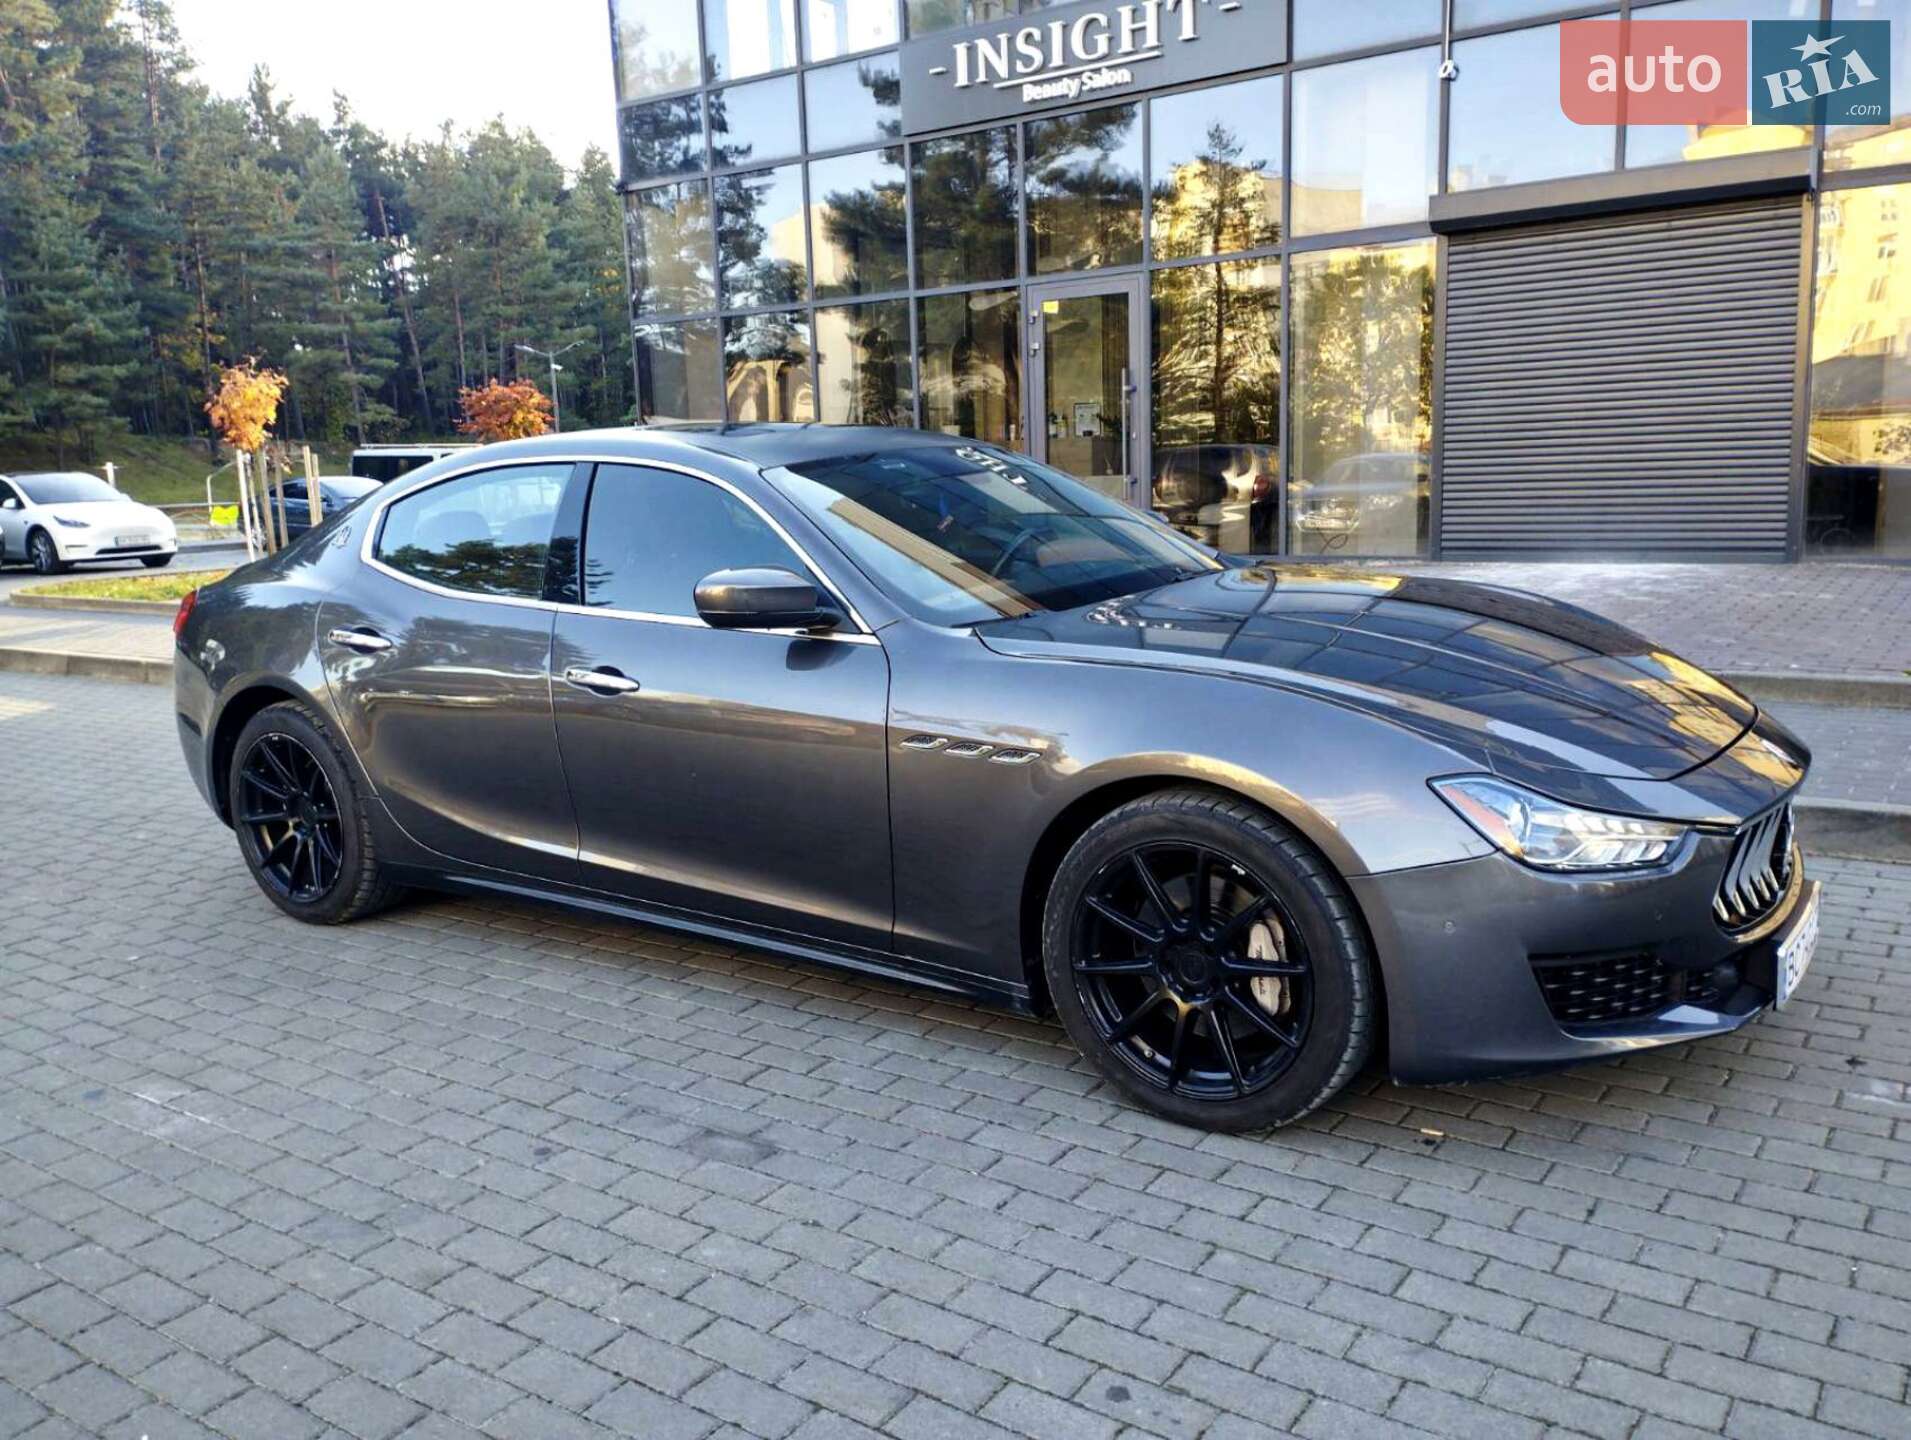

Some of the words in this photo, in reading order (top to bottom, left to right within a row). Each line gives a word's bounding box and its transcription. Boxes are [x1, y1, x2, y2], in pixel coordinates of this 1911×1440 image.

[953, 0, 1208, 87] INSIGHT
[1022, 78, 1080, 102] Beauty
[1080, 67, 1133, 91] Salon
